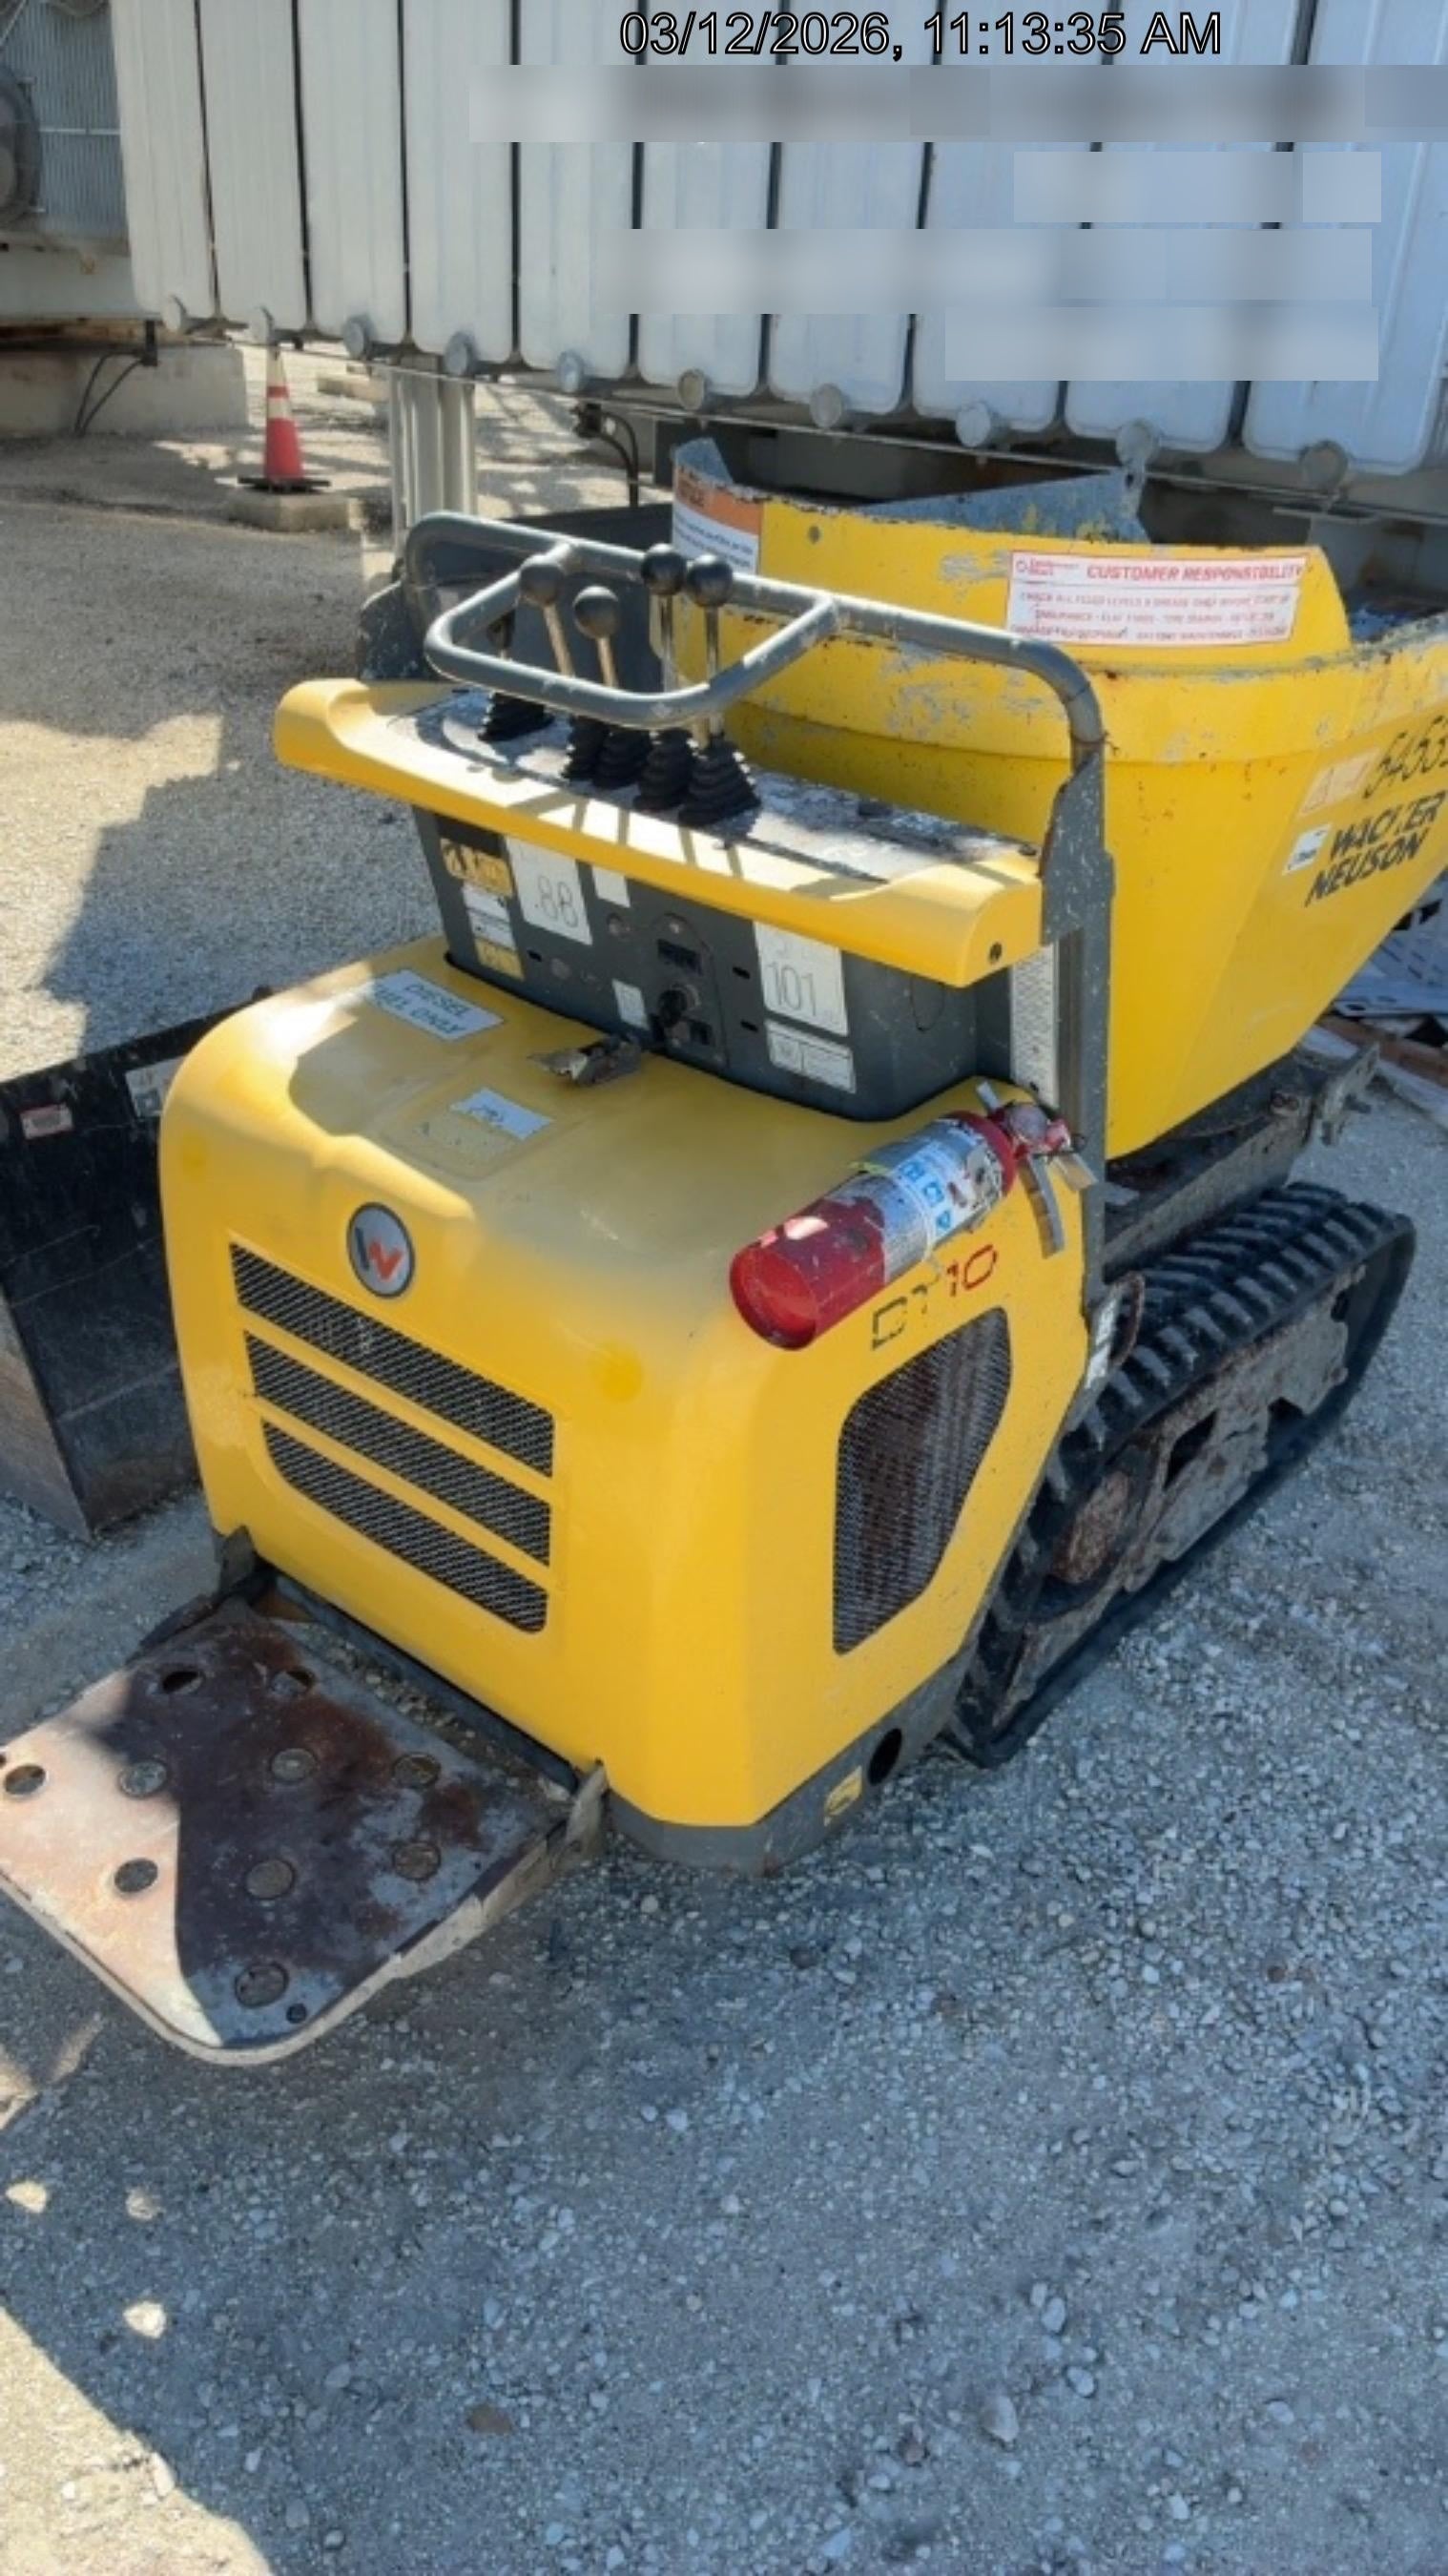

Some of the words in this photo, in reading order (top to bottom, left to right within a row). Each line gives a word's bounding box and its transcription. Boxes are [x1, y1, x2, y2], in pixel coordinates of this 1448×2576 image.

[1086, 565, 1180, 580] CUSTOMER
[1304, 826, 1431, 907] NEUSON
[767, 961, 817, 1018] 101
